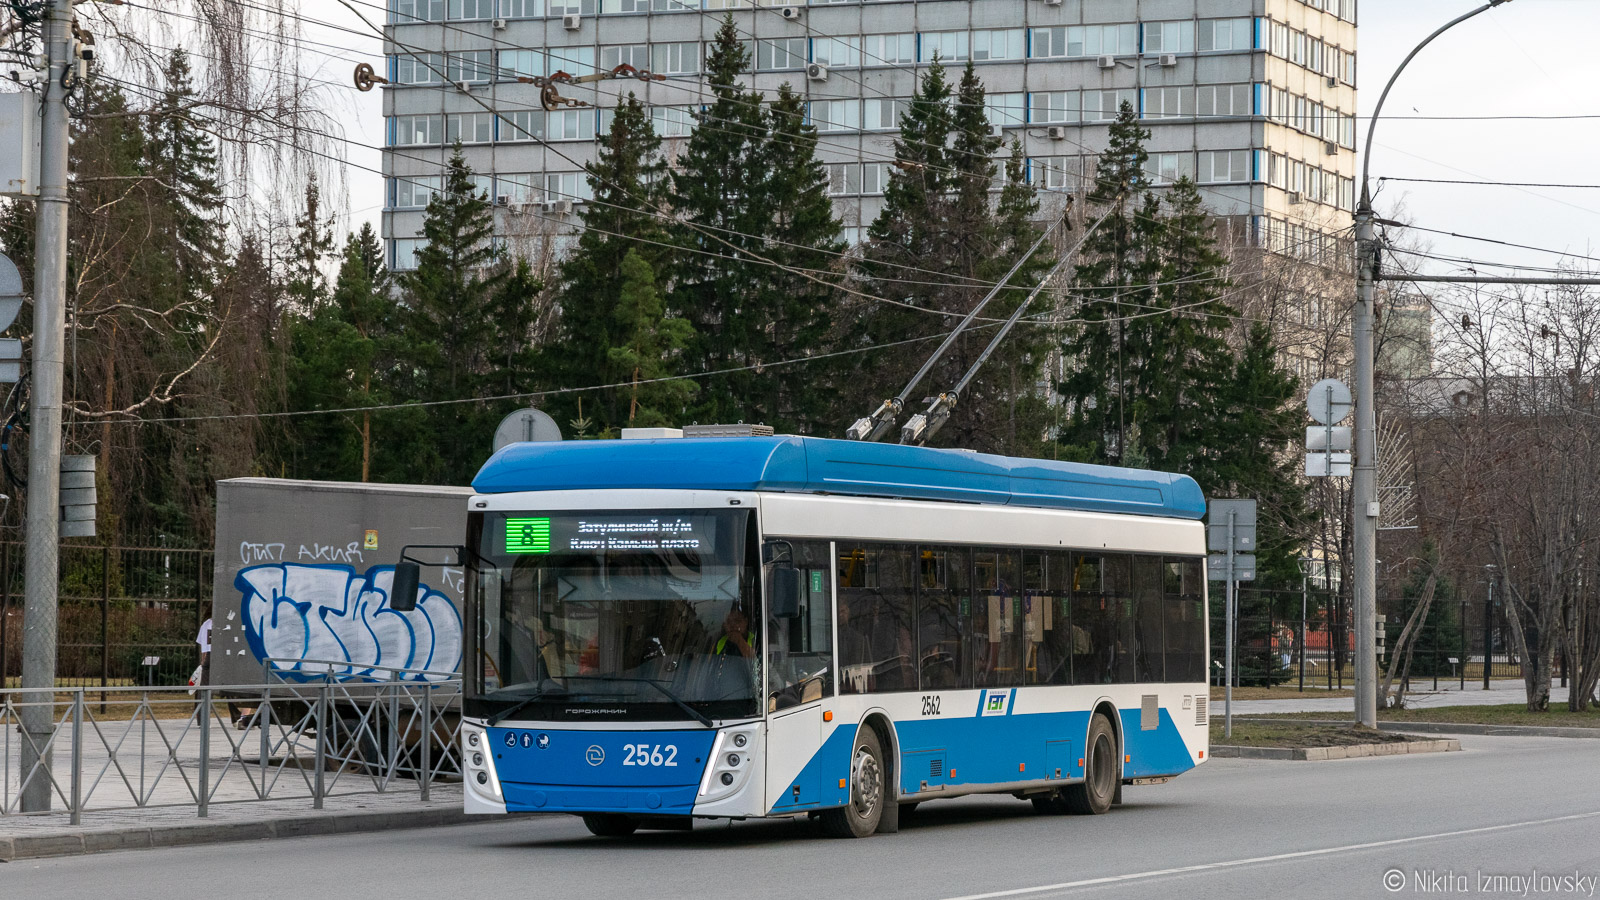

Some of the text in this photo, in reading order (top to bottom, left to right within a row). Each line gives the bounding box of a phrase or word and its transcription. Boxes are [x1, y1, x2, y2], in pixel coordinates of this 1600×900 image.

[521, 524, 534, 546] 8
[662, 519, 692, 535] ж/м
[922, 695, 941, 716] 2562
[622, 743, 678, 767] 2562
